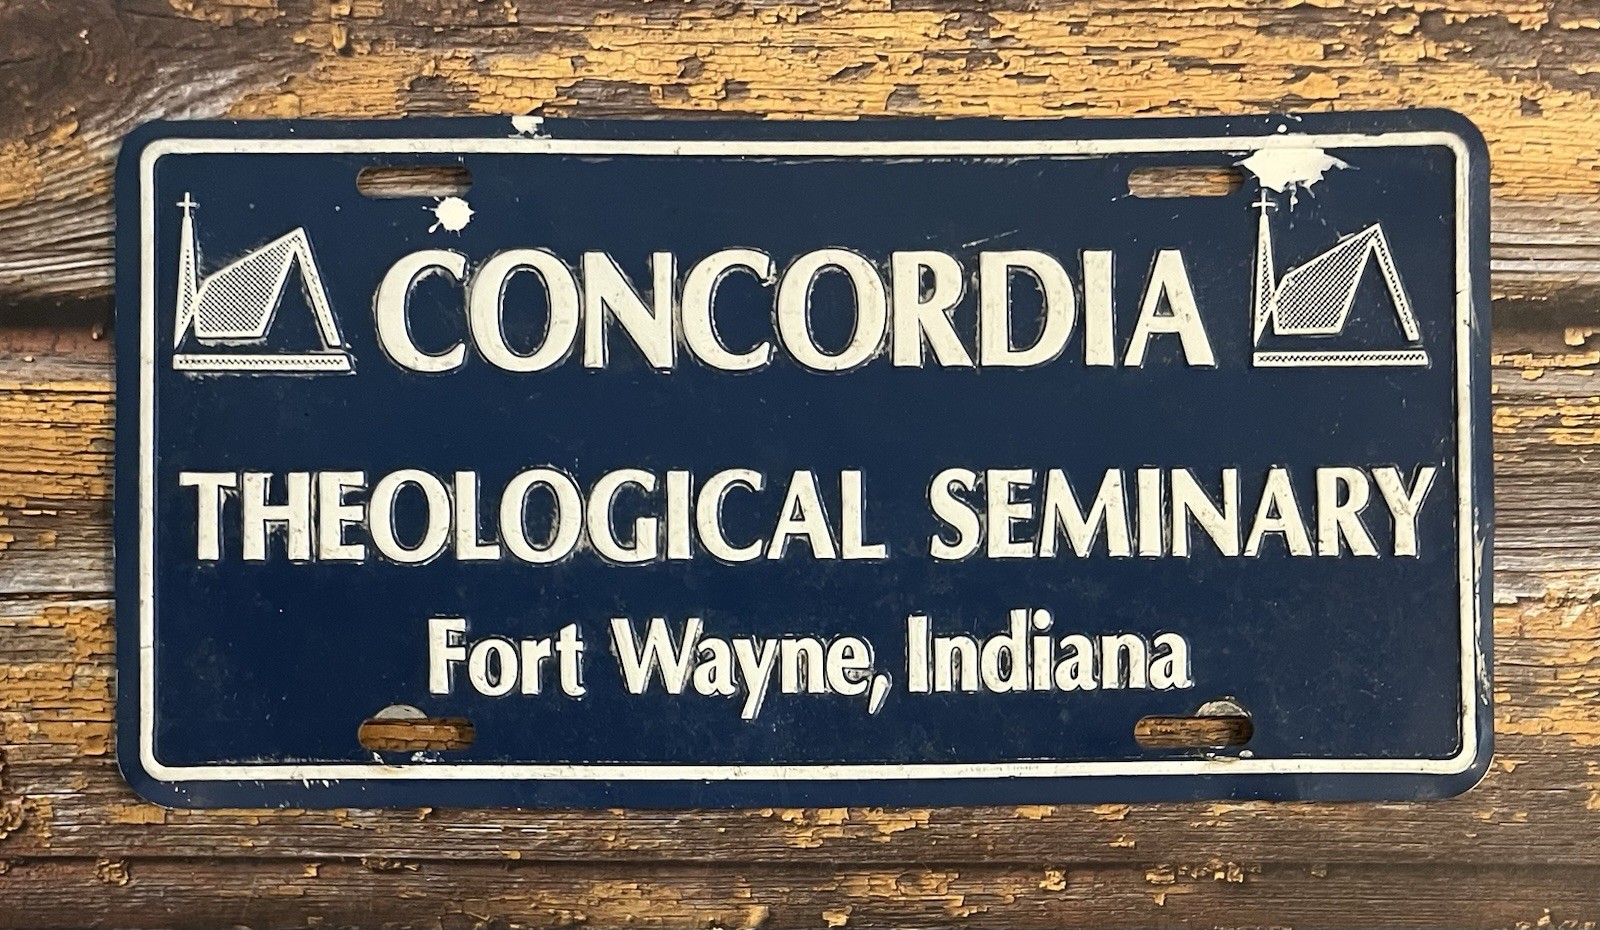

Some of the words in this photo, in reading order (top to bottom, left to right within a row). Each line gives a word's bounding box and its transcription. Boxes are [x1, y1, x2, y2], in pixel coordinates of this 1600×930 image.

[375, 248, 1216, 373] CONCORDIA
[178, 468, 887, 564] THEOLOGICAL
[929, 466, 1437, 560] SEMINARY
[428, 617, 585, 697] Fort
[609, 617, 891, 720] Wayne,
[907, 609, 1193, 694] Indiana
